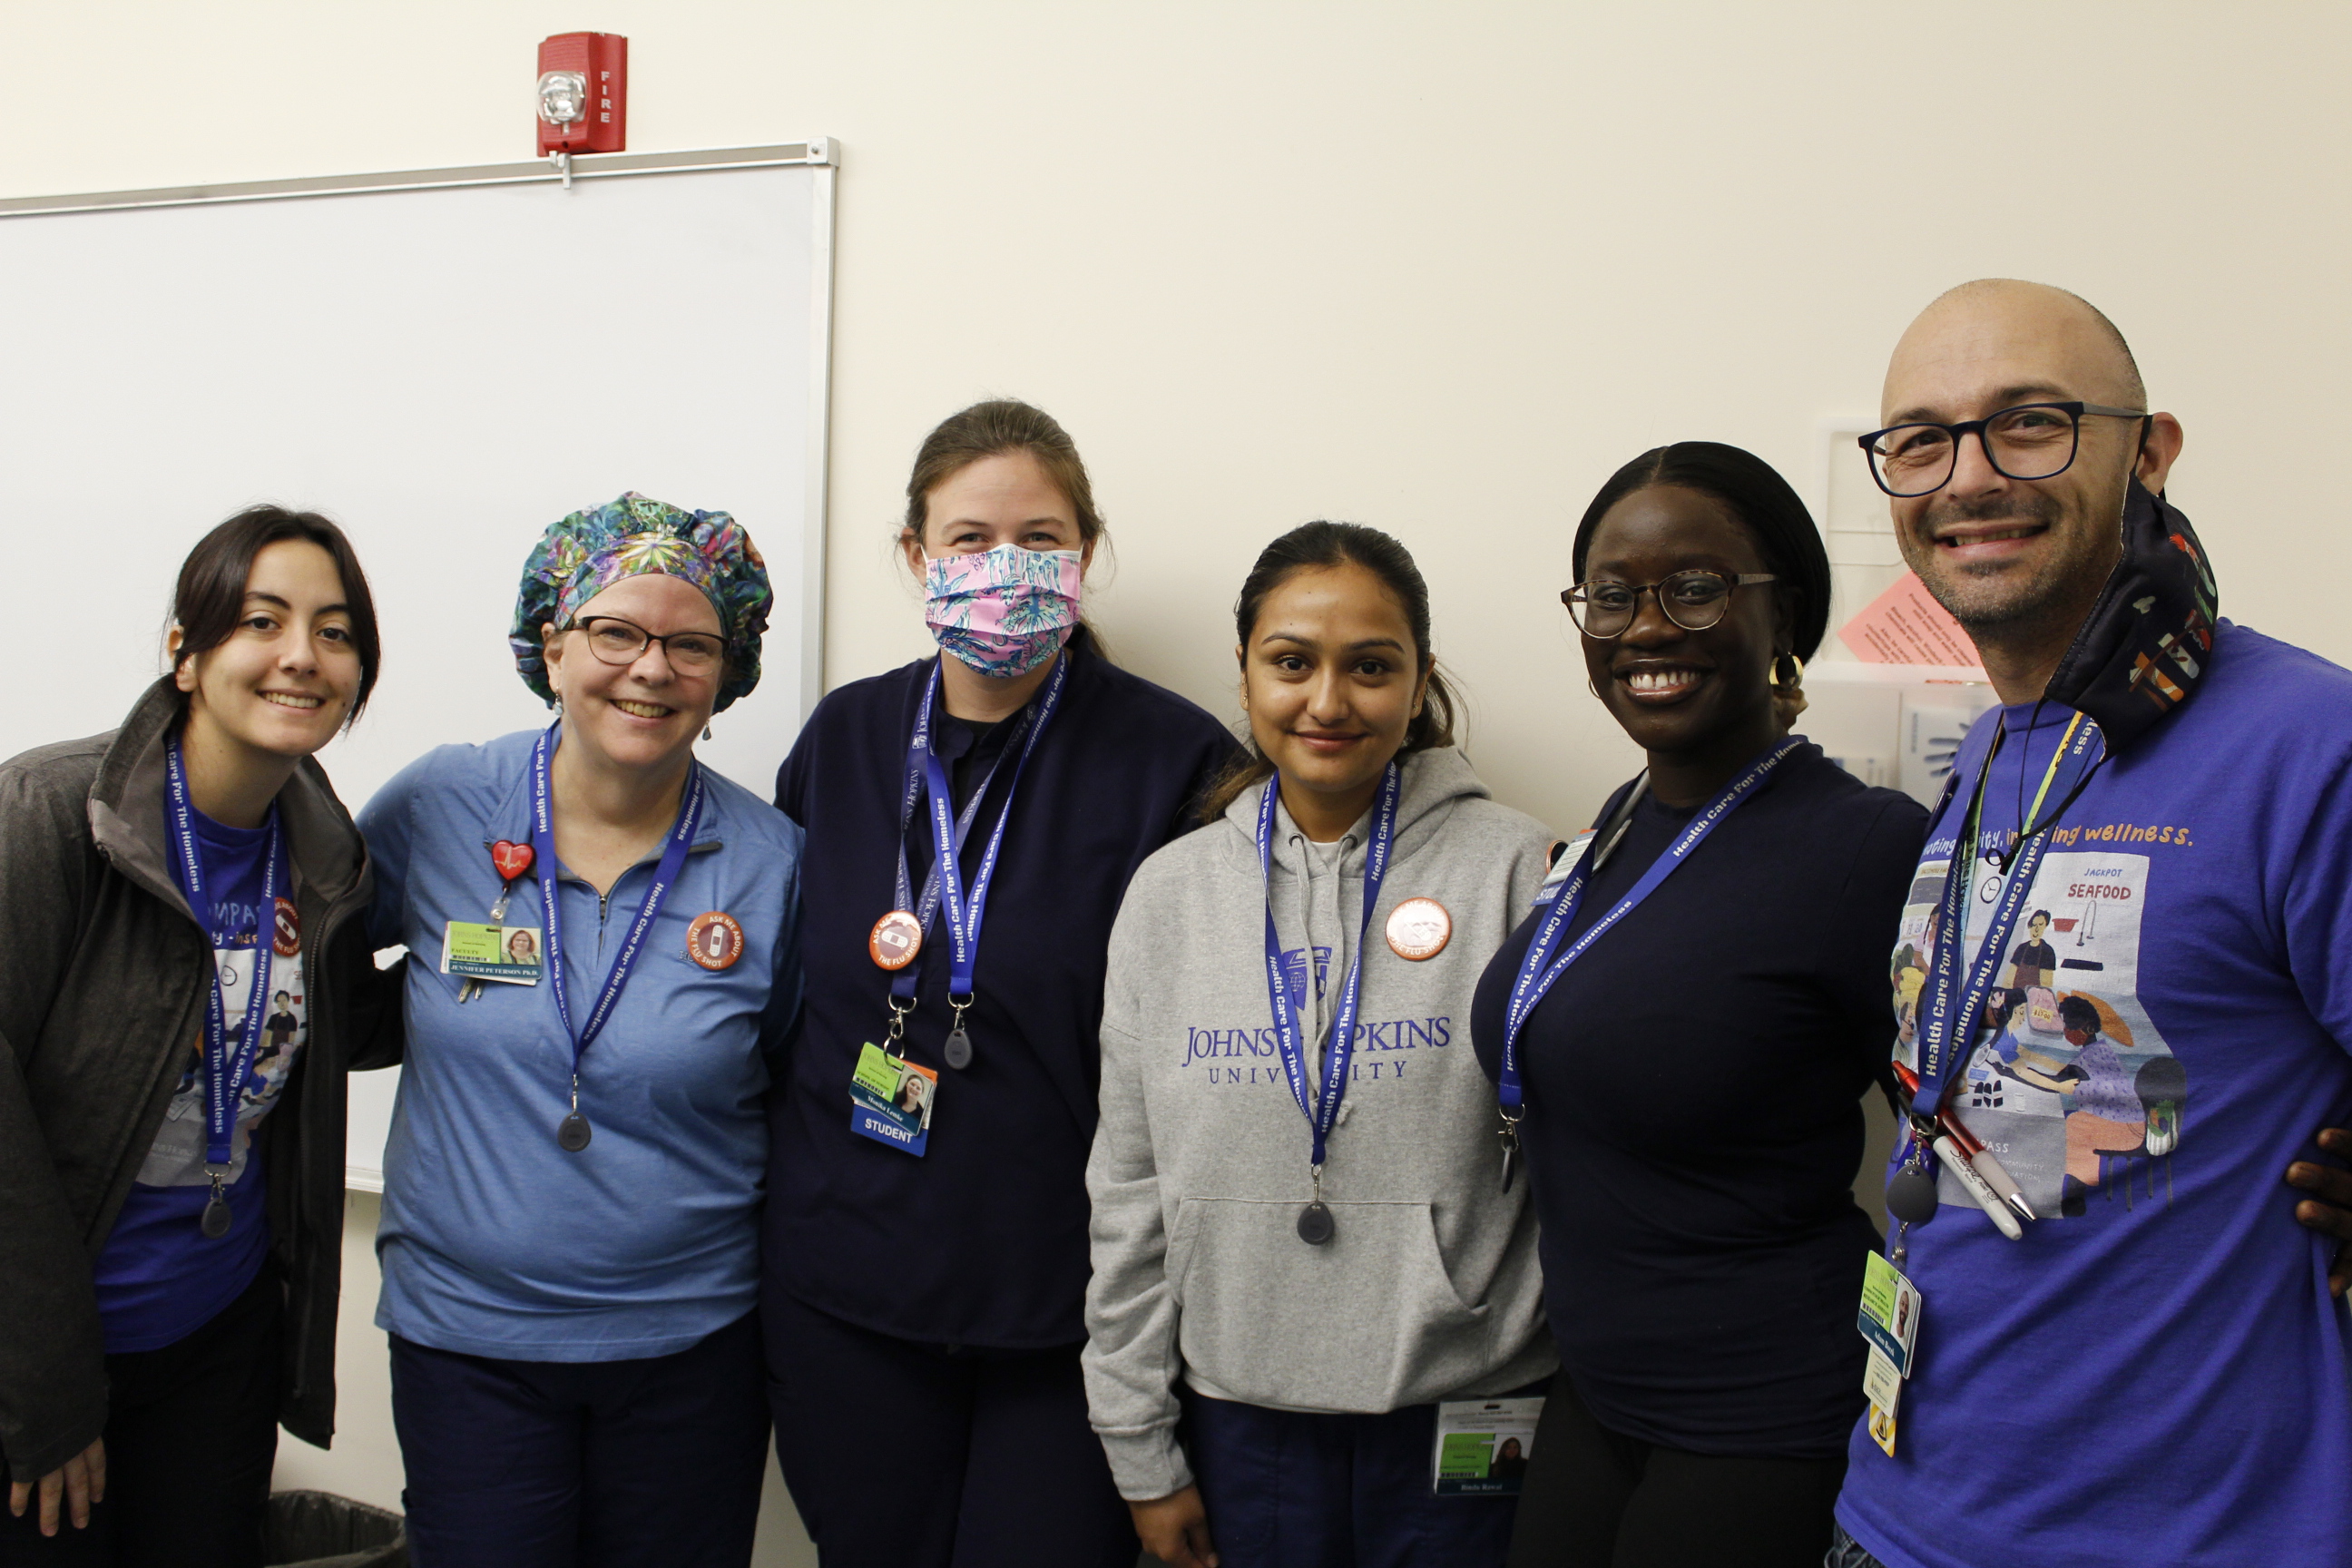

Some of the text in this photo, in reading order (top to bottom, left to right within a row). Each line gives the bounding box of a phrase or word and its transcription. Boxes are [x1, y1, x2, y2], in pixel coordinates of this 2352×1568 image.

[601, 72, 611, 123] FIRE
[1025, 671, 1063, 758] For The Homeless
[168, 751, 179, 779] Care
[536, 753, 544, 770] For
[172, 781, 182, 804] For
[536, 771, 544, 797] Care
[1386, 778, 1396, 792] The
[177, 806, 188, 828] The
[536, 798, 547, 833] Health
[677, 795, 699, 841] Homeless
[1382, 794, 1393, 812] For
[1672, 757, 1778, 857] Health Care For The
[1378, 812, 1389, 840] Care
[2085, 823, 2193, 847] wellness.
[182, 831, 200, 892] Homeless
[981, 861, 991, 881] For
[1371, 841, 1386, 881] Health
[2084, 867, 2123, 878] JACKPOT
[937, 798, 965, 963] Health Care For The Homeless
[973, 882, 985, 903] The
[2068, 883, 2132, 900] SEAFOOD
[544, 879, 557, 935] Homeless
[1555, 877, 1583, 916] Health
[2001, 880, 2024, 922] Care
[550, 936, 558, 957] The
[724, 918, 737, 930] ME
[731, 930, 741, 956] ABOUT
[873, 929, 881, 944] ASK
[1539, 917, 1561, 946] Care
[1988, 925, 2005, 956] For
[583, 882, 664, 1041] Health Care For The Homeless
[691, 927, 722, 967] THE FLU SHOT
[878, 936, 918, 966] THE FLU SHOT
[1516, 995, 1538, 1024] Care
[1537, 971, 1555, 994] For
[1554, 951, 1576, 970] The
[1576, 900, 1632, 950] Homeless
[1530, 946, 1544, 971] For
[1926, 844, 1963, 1077] Health Care For The Homeless
[252, 949, 268, 1009] Homeless
[450, 965, 485, 973] JENNIFER
[485, 967, 521, 975] PETERSON
[1517, 973, 1534, 996] The
[1975, 958, 1994, 988] The
[248, 1011, 259, 1032] The
[1269, 956, 1298, 1076] Health Care For The
[240, 1035, 253, 1057] For
[1181, 1026, 1276, 1067] JOHNS
[210, 990, 224, 1134] Care For The Homeless
[230, 1057, 245, 1088] Care
[1209, 1060, 1407, 1083] UNIVITY
[1321, 1005, 1351, 1133] Health Care For The
[865, 1118, 913, 1143] STUDENT
